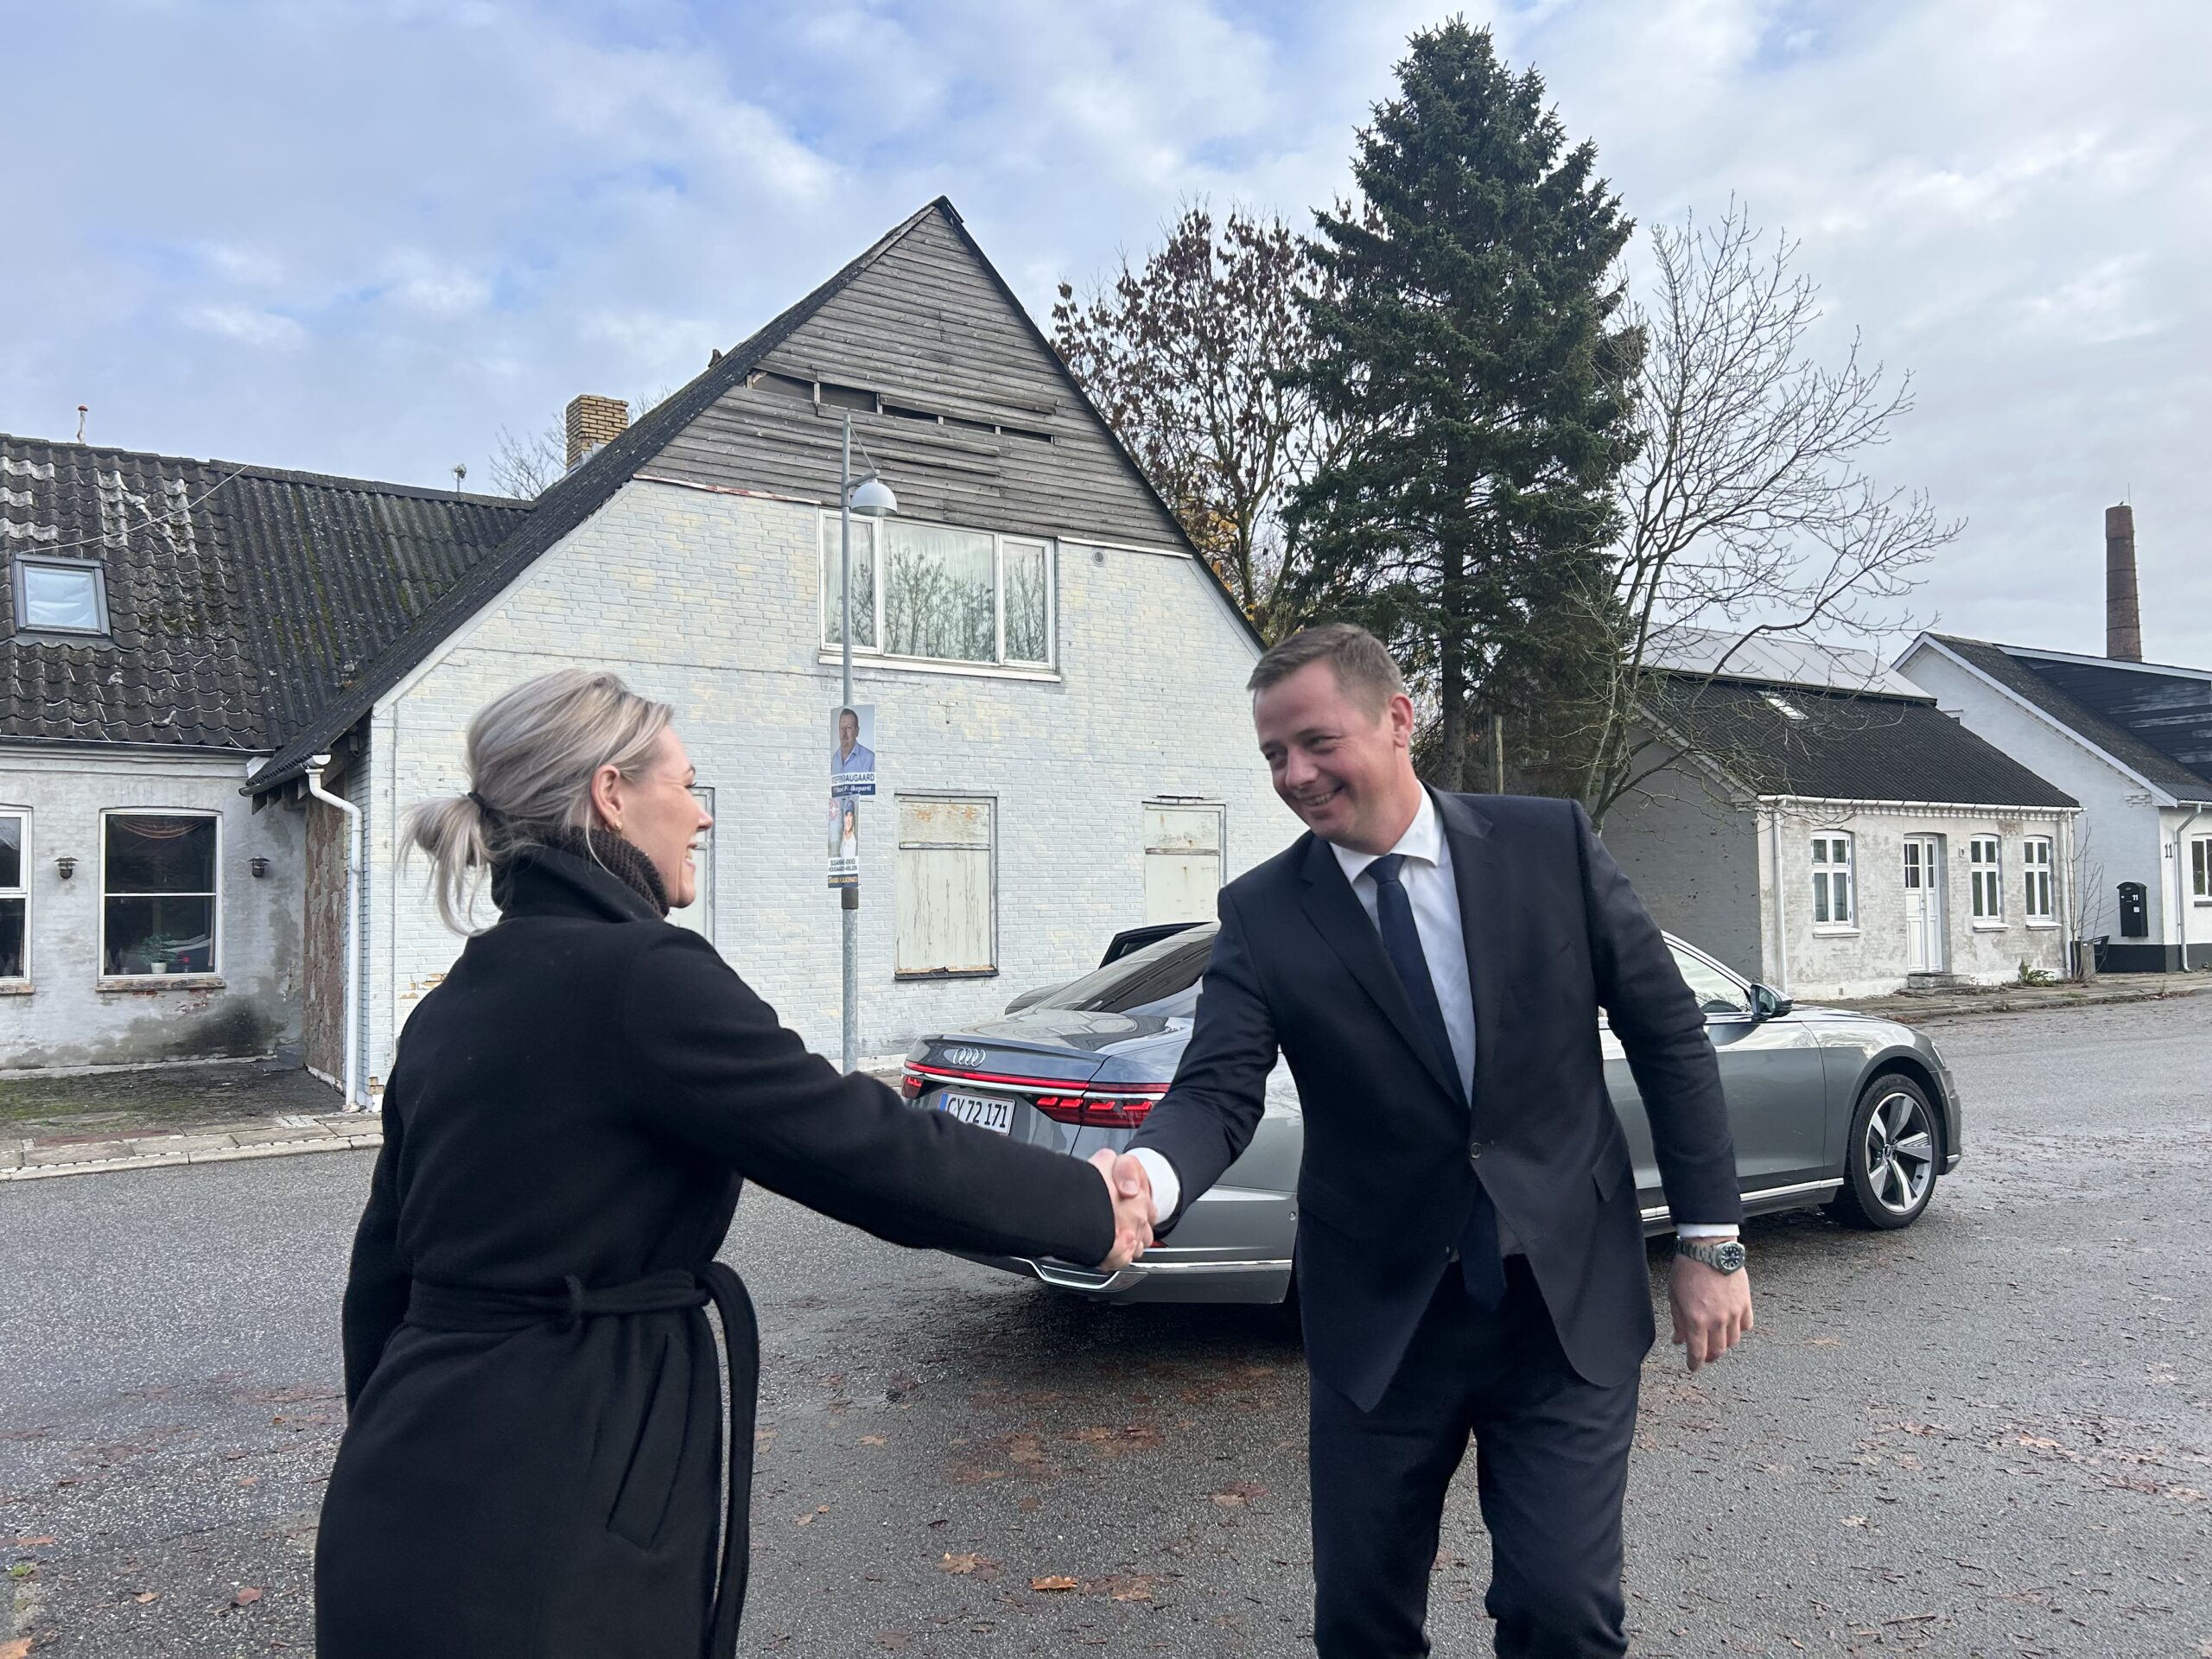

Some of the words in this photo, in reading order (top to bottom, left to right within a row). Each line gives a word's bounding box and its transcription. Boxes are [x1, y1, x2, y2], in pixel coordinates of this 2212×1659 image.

[2164, 842, 2173, 858] 11
[965, 1099, 982, 1123] 72
[984, 1103, 1007, 1128] 171
